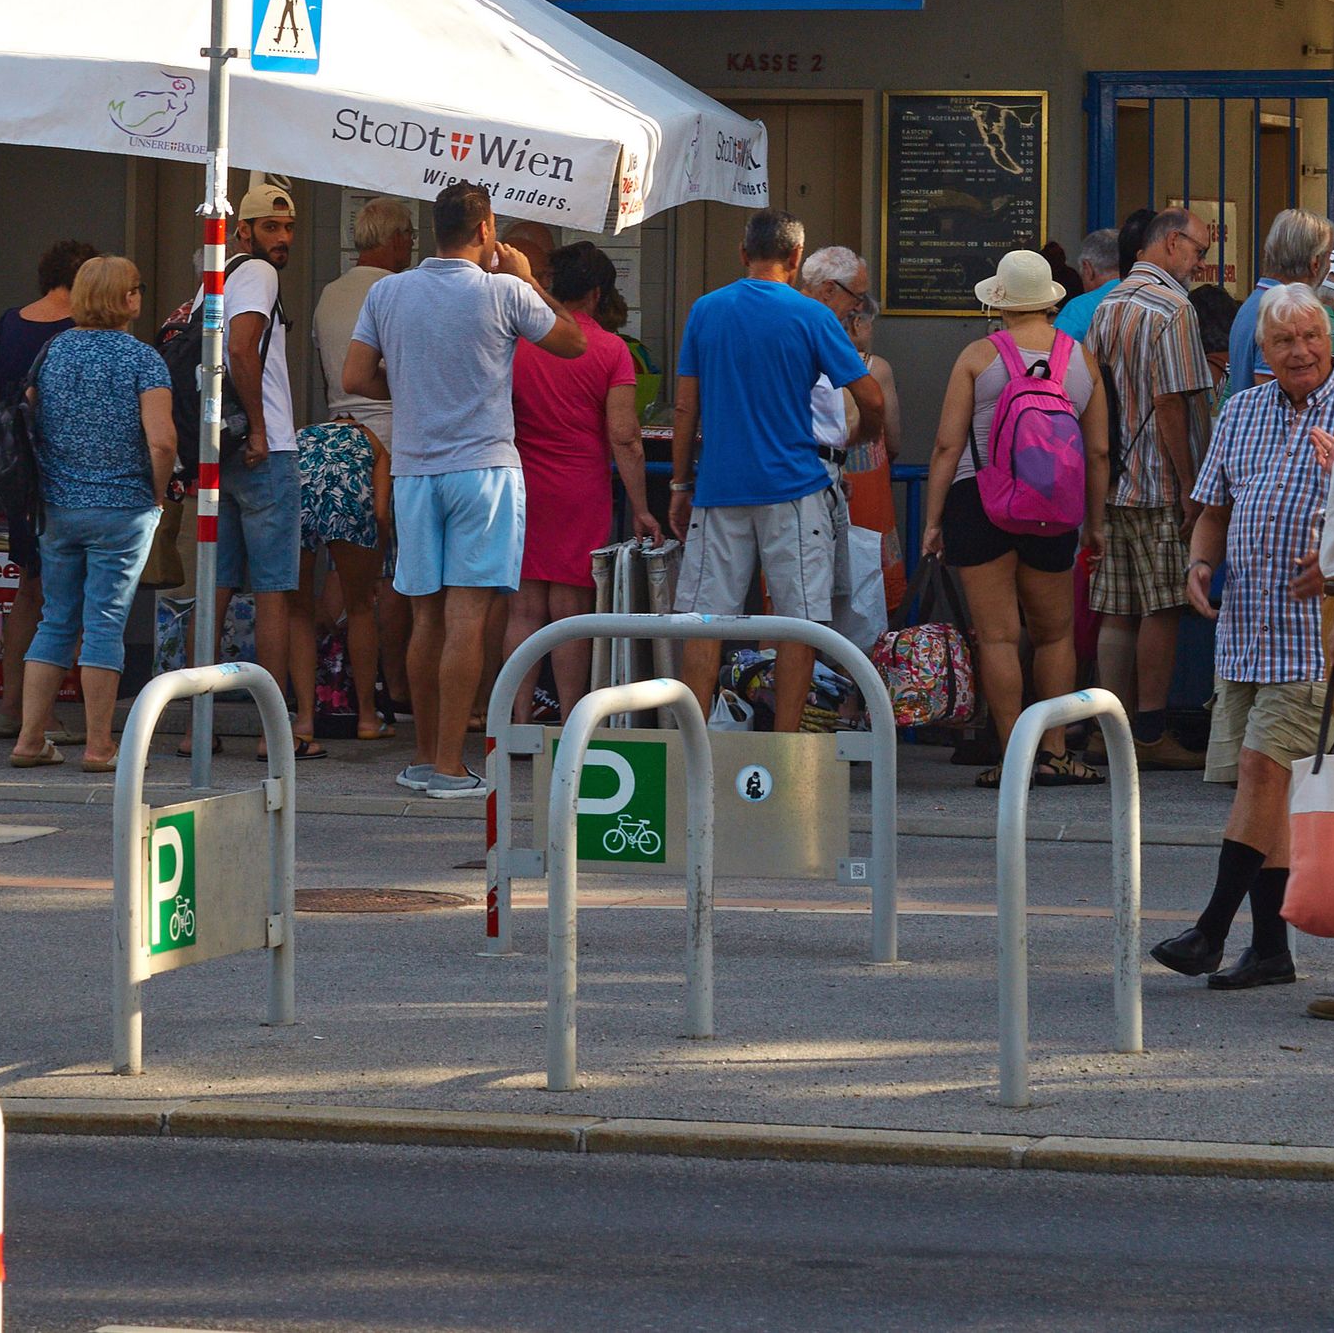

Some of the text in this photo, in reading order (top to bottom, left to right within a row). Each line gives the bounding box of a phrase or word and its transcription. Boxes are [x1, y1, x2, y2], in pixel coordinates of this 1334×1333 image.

[727, 53, 823, 72] KASSE 2
[129, 136, 207, 154] UNSERE BÄDE
[479, 132, 574, 182] Wien
[505, 186, 572, 212] anders.
[152, 826, 184, 946] P
